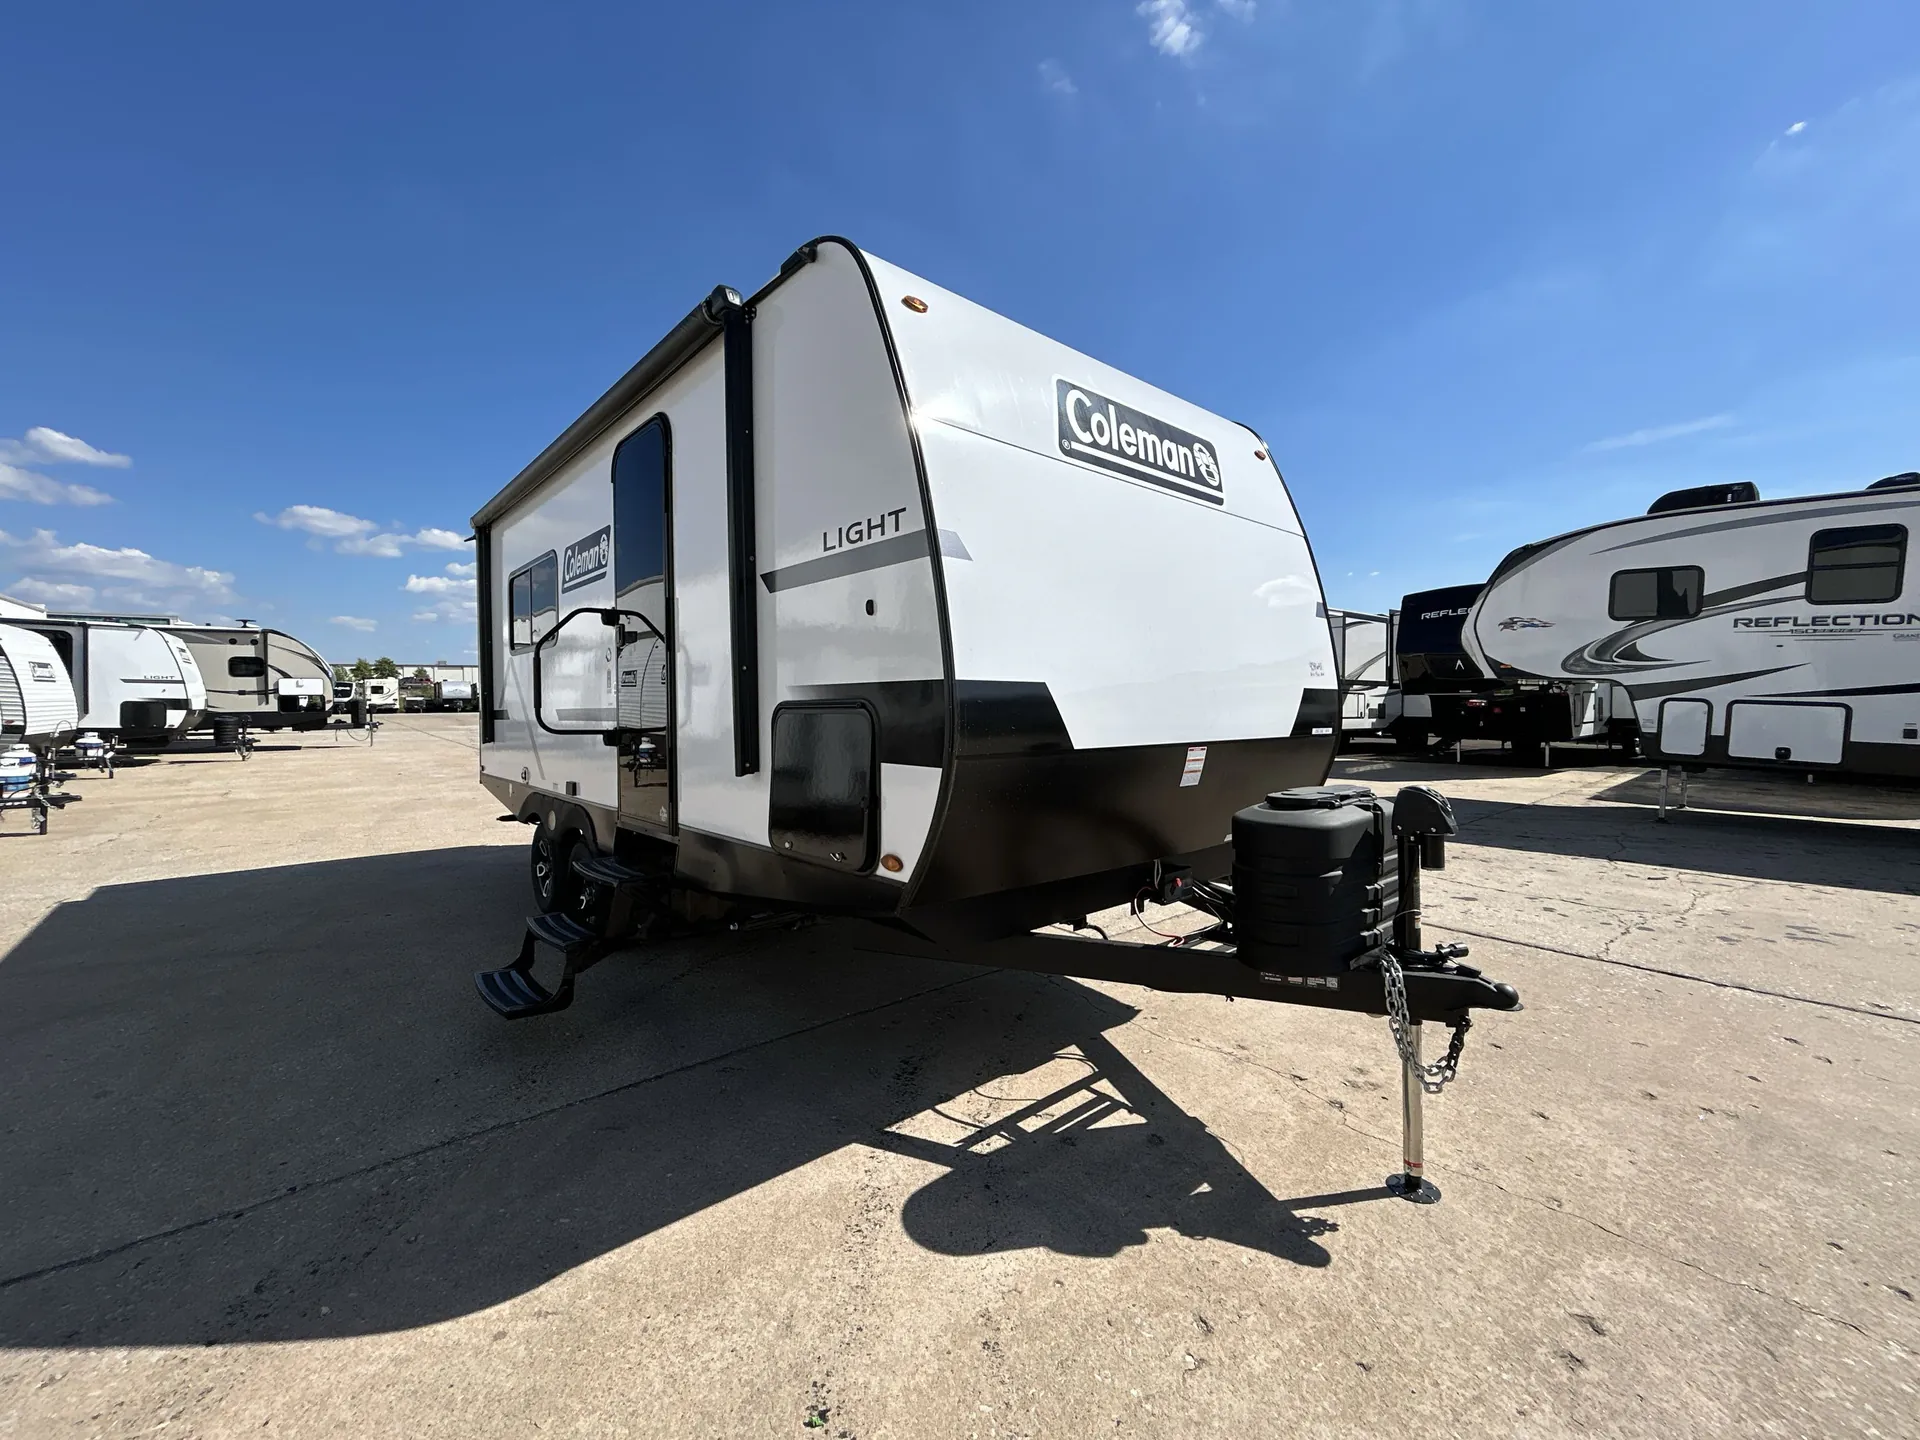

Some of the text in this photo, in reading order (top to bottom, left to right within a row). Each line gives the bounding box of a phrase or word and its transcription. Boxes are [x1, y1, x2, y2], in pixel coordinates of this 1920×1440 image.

[1066, 389, 1196, 478] Coleman
[823, 507, 907, 552] LIGHT
[564, 545, 600, 581] Coleman
